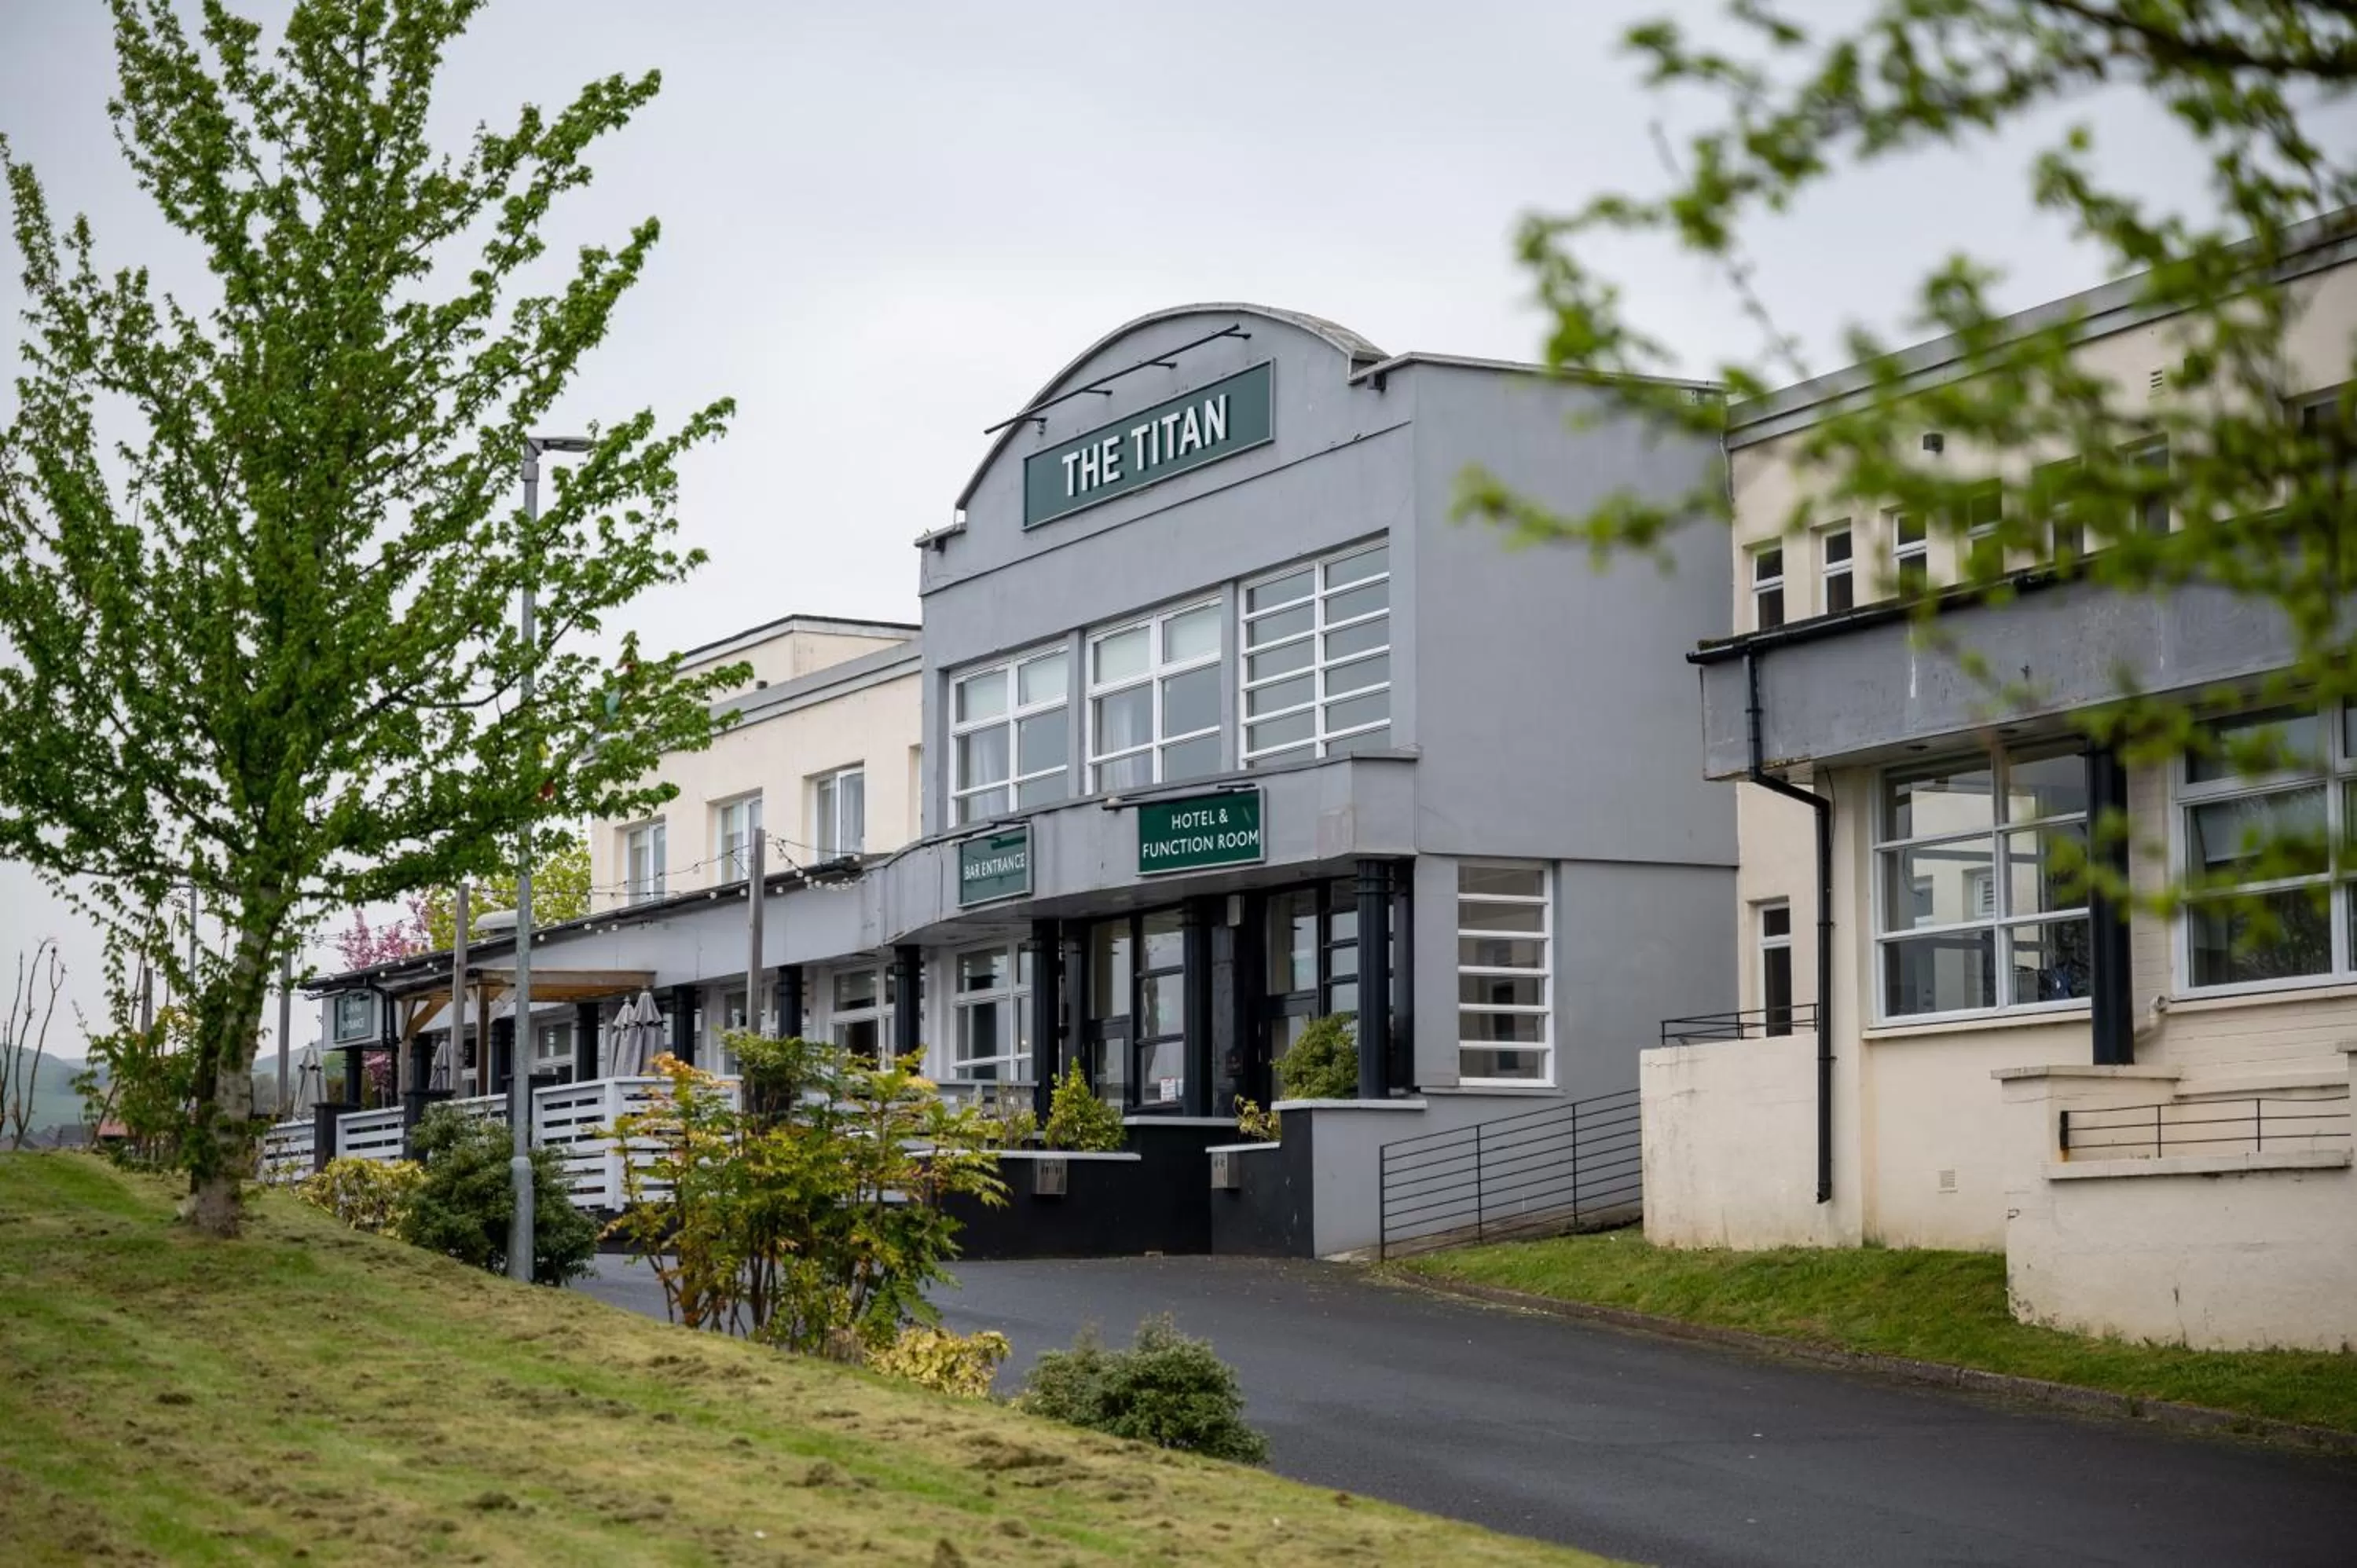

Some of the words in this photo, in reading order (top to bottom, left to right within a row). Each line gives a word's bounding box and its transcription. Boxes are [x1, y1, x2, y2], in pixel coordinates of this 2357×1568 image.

[1062, 435, 1121, 496] THE
[1131, 394, 1226, 471] TITAN
[1171, 810, 1215, 830] HOTEL
[1219, 808, 1228, 824] &
[1142, 835, 1214, 859] FUNCTION
[1219, 829, 1259, 849] ROOM
[964, 863, 981, 880] BAR
[981, 852, 1025, 877] ENTRANCE
